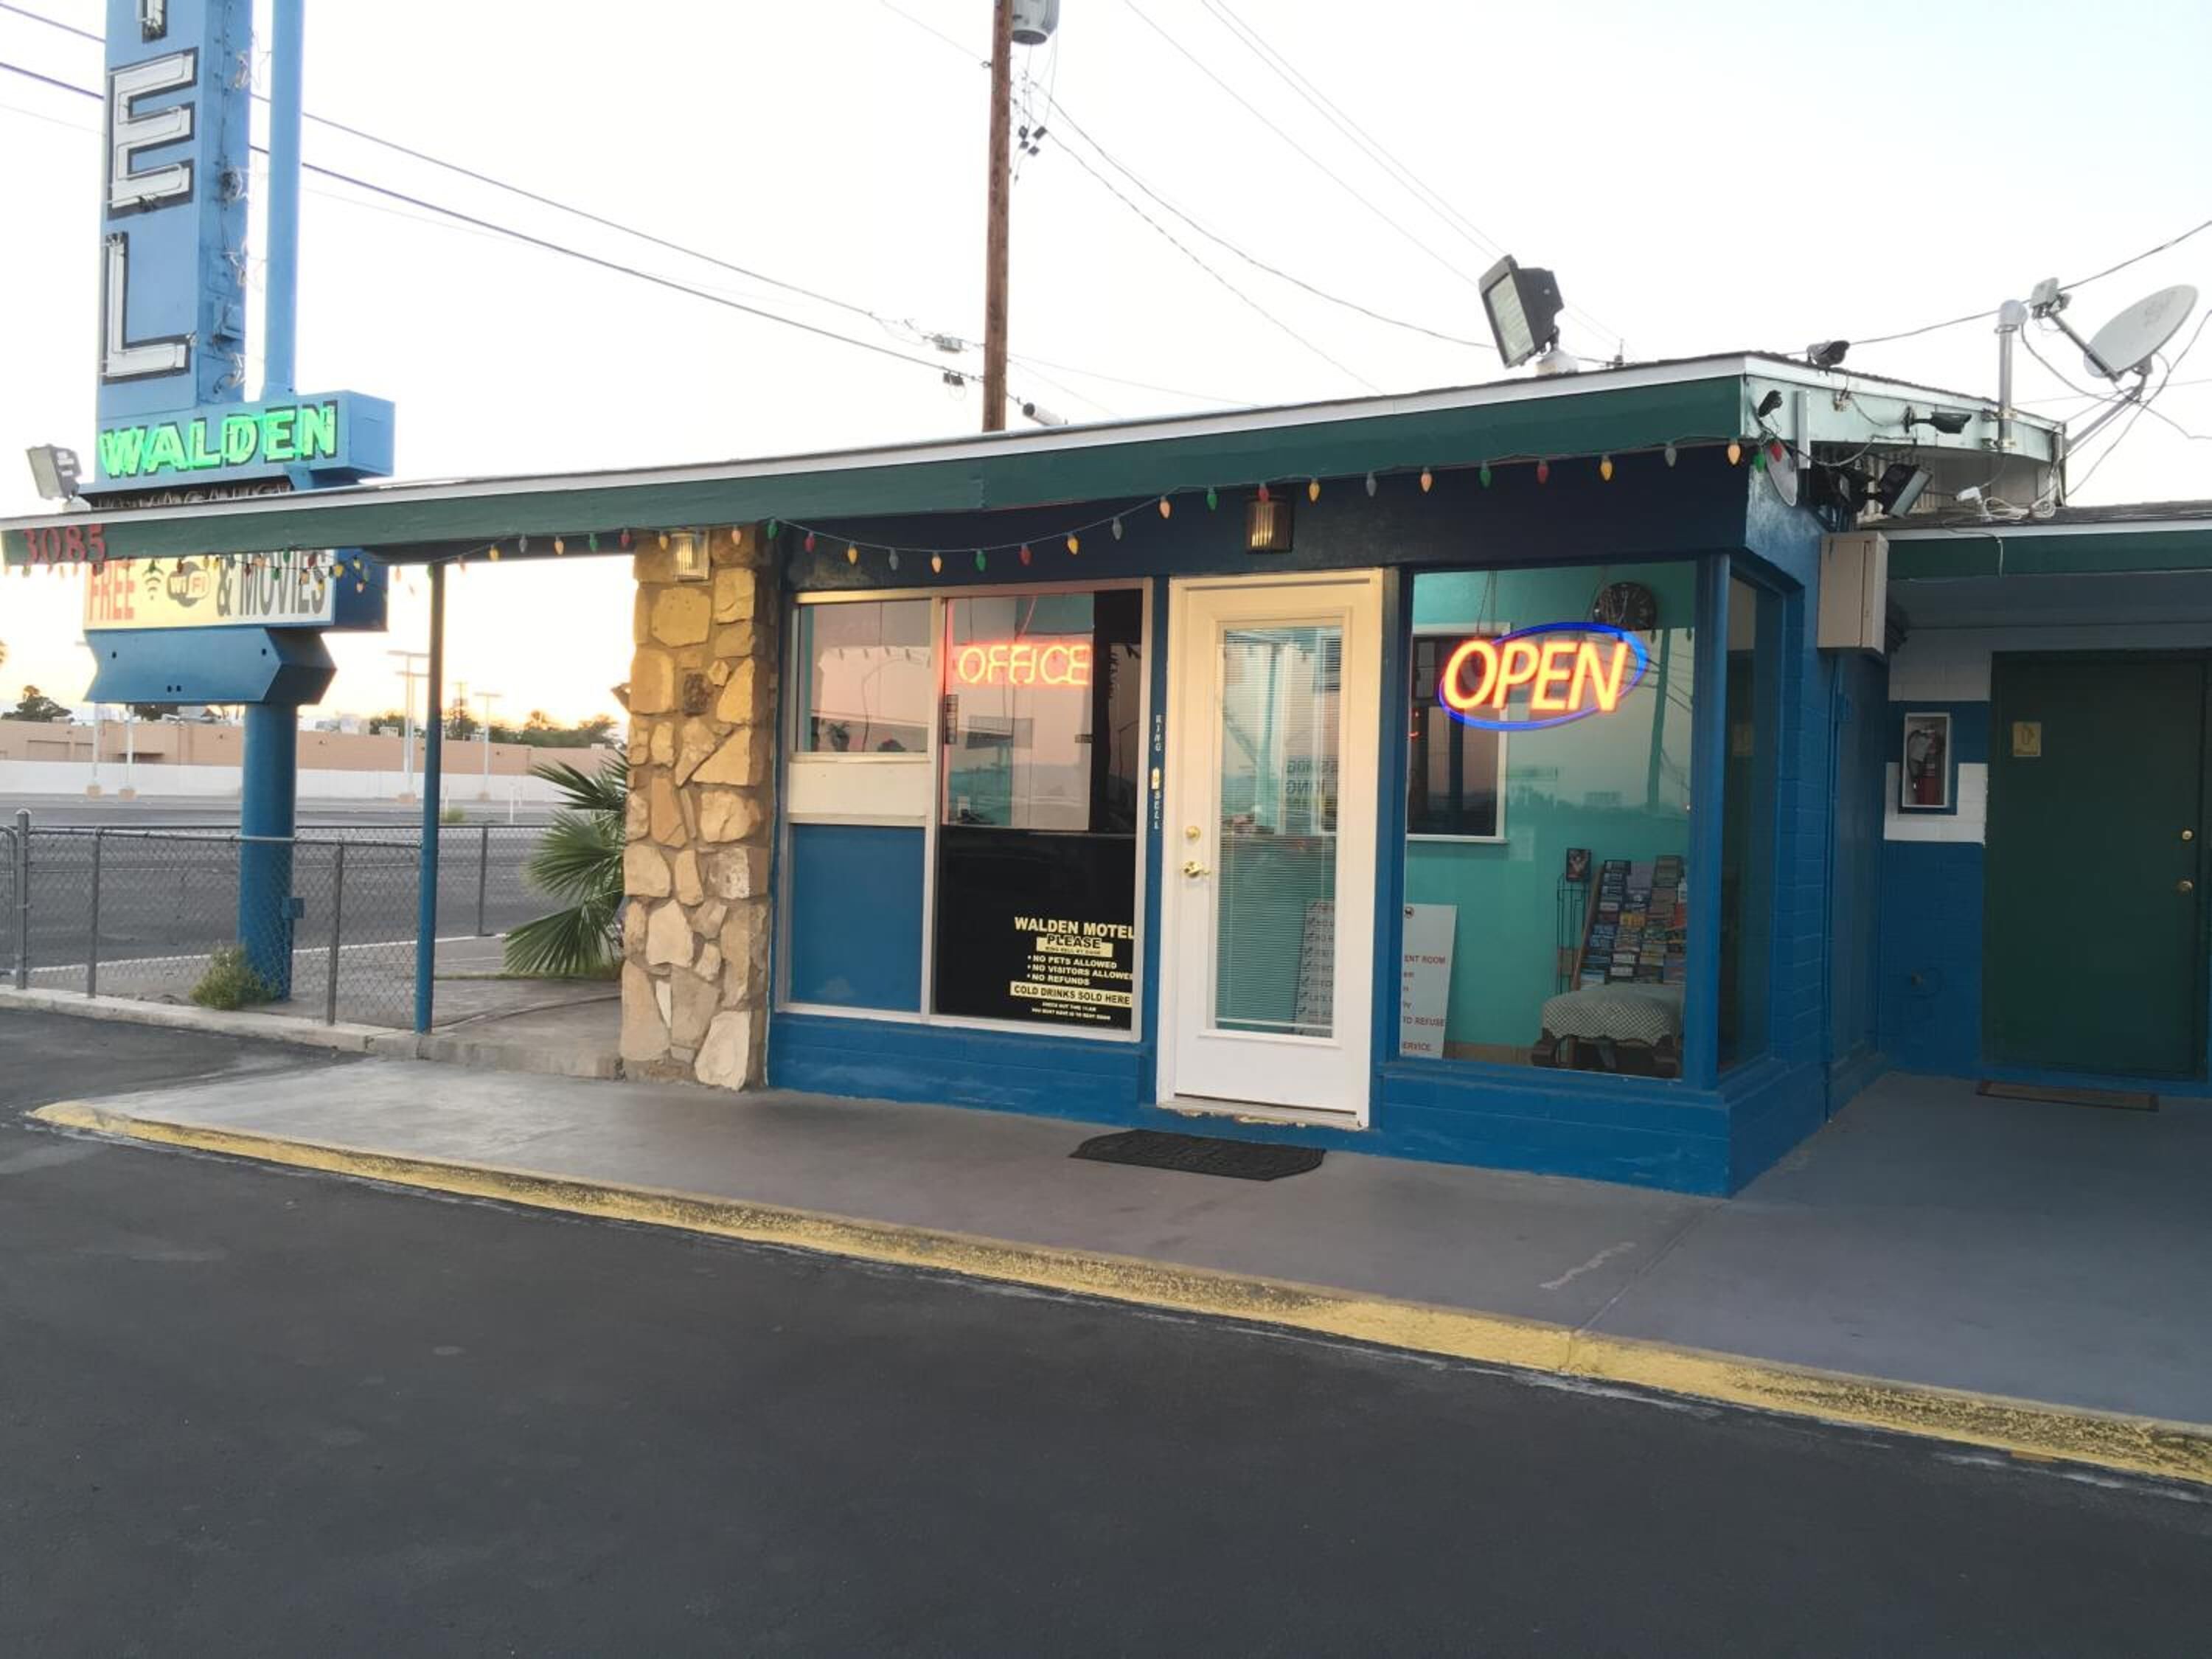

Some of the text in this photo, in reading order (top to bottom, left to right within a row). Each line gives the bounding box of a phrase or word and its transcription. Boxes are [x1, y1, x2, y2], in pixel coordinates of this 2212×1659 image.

[102, 0, 199, 386] EL
[98, 400, 338, 479] WALDEN
[24, 523, 106, 566] 3085
[959, 643, 1091, 686] OFFICE
[1443, 639, 1629, 712] OPEN
[1014, 917, 1134, 939] WALDEN MOTEL
[1047, 933, 1102, 949] PLEASE
[1032, 964, 1046, 972] NO
[1048, 966, 1090, 977] VISITORS
[1048, 956, 1071, 965] PETS
[1074, 959, 1117, 970] ALLOWED
[1032, 973, 1091, 986] NO REFUNDS
[1014, 985, 1130, 1005] COLD DRINKS SOLD HERE
